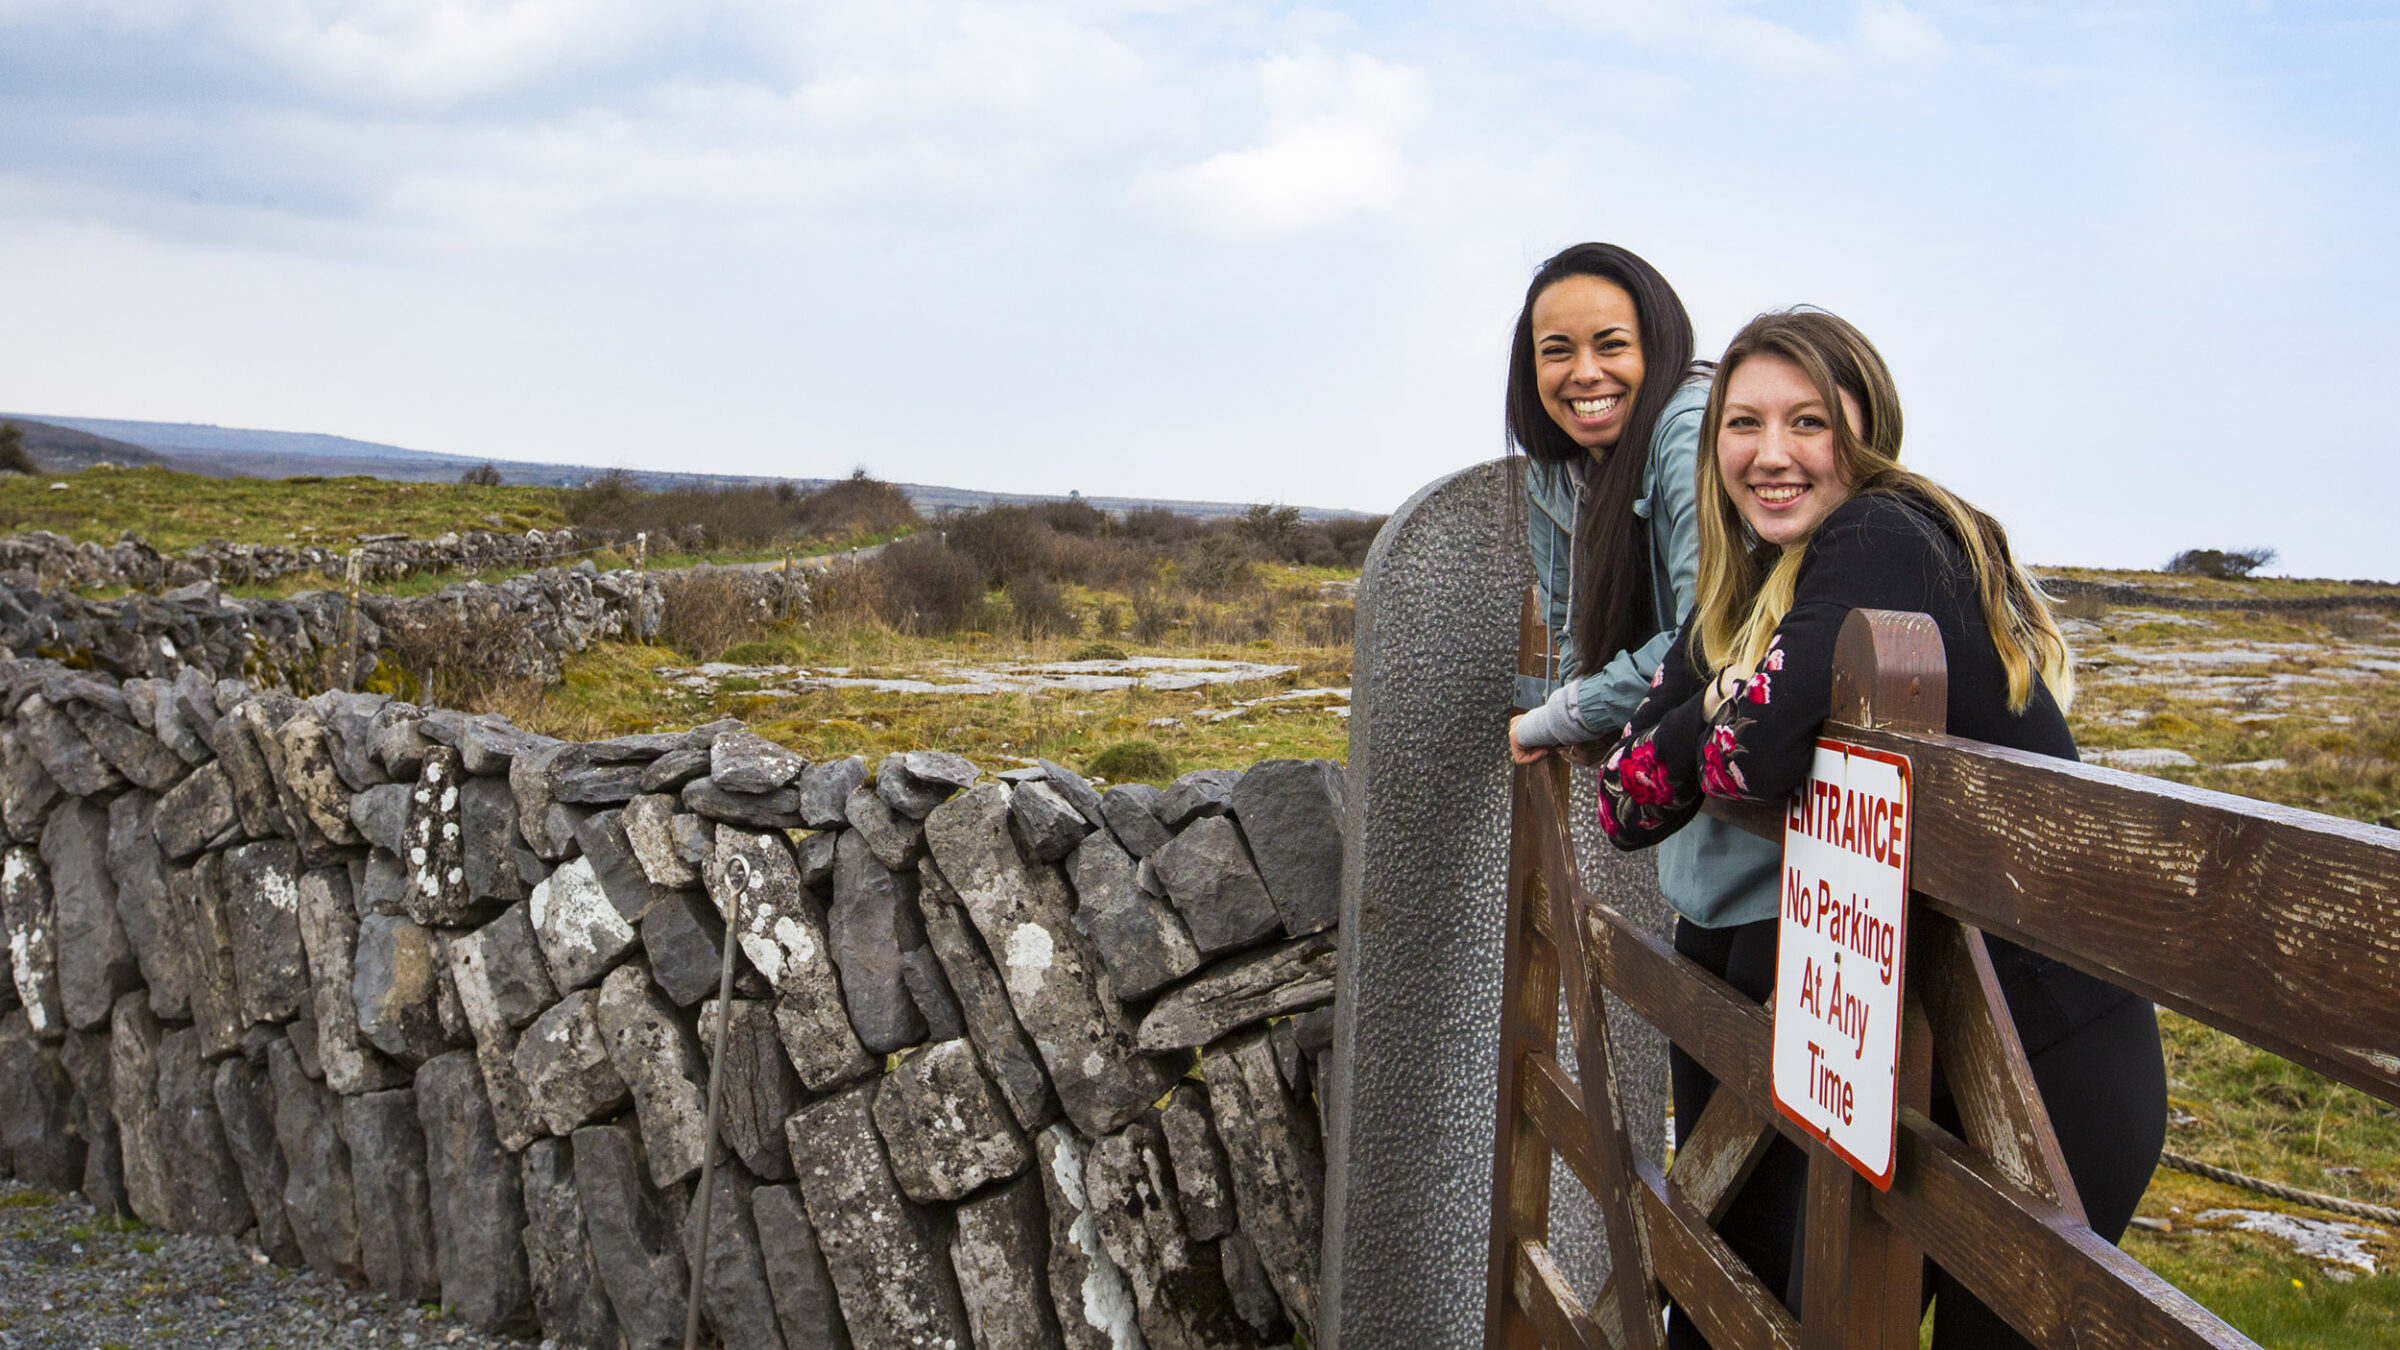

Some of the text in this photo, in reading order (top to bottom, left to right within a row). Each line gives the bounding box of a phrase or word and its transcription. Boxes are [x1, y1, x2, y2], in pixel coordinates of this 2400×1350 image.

[1788, 777, 1903, 869] ENTRANCE
[1787, 866, 1894, 985] No Parking
[1800, 956, 1869, 1060] At Any
[1808, 1040, 1853, 1126] Time
